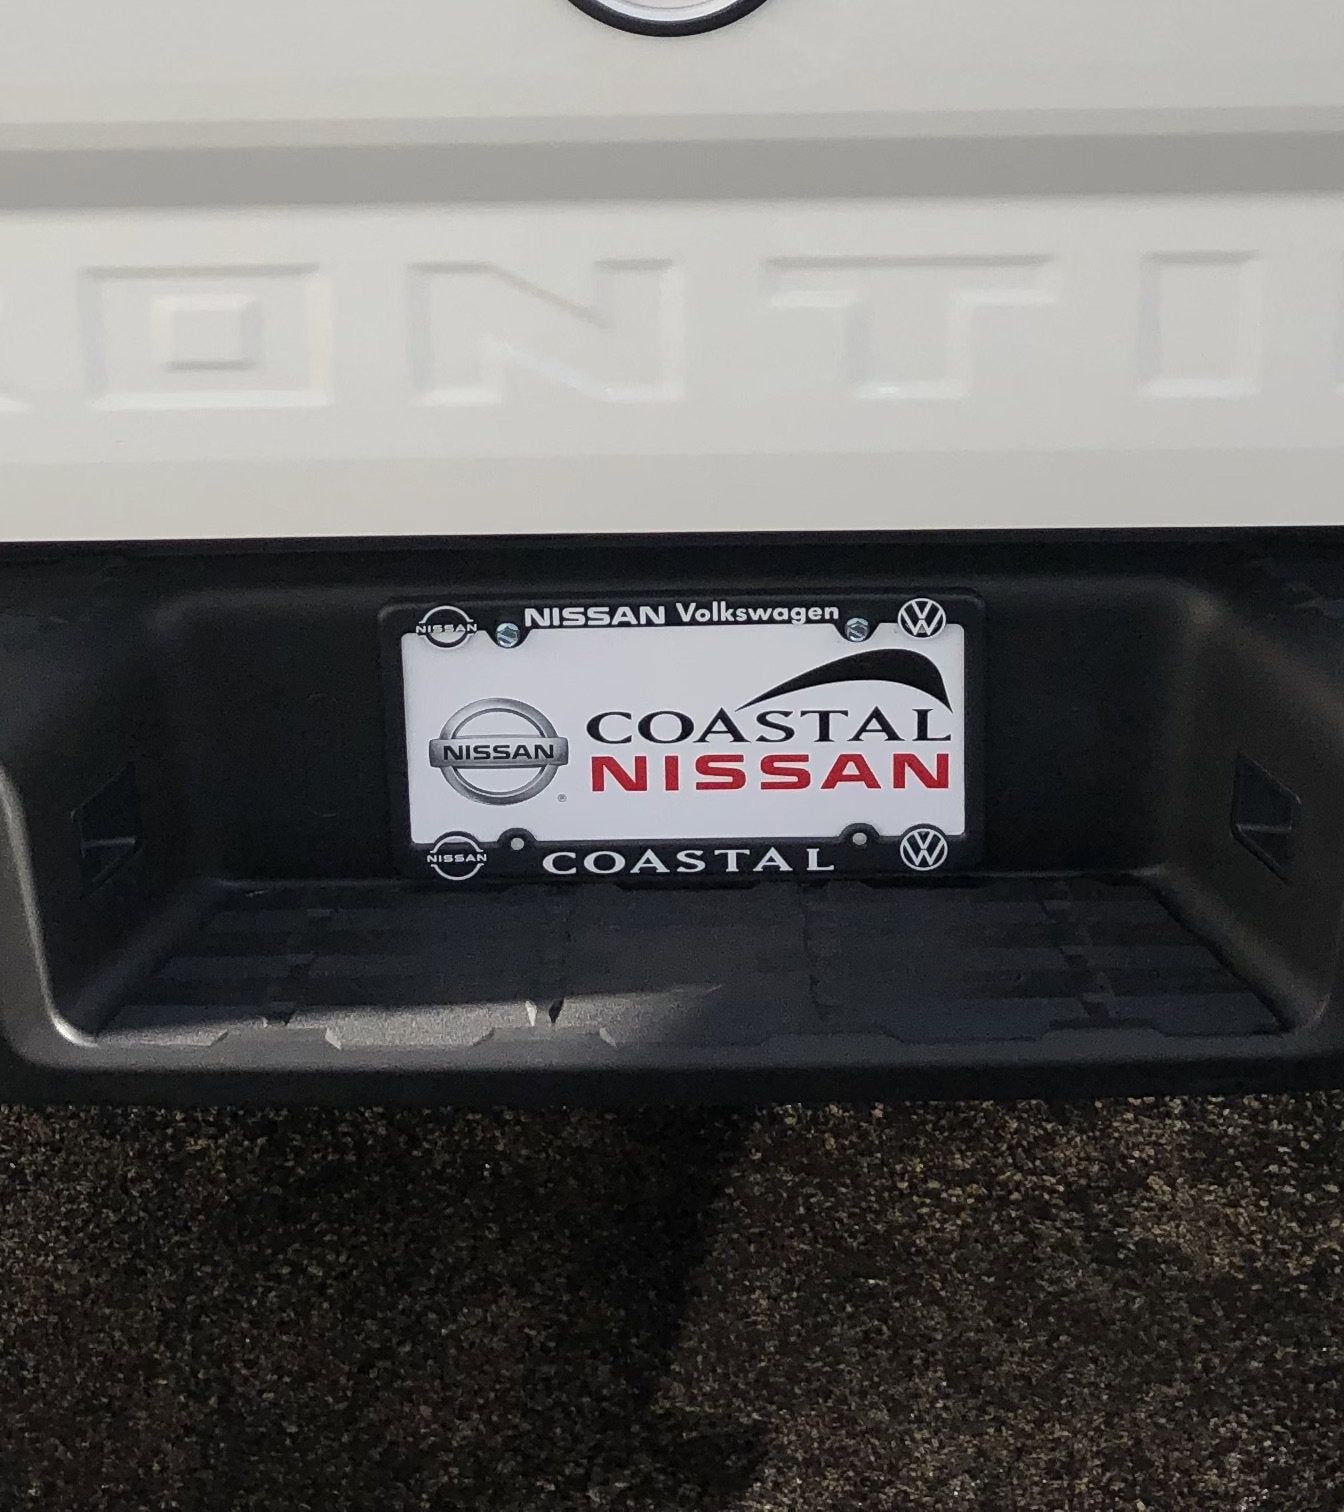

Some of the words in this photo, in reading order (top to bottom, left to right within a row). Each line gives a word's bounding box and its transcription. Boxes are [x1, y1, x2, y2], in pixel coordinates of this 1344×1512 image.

[524, 606, 666, 628] NISSAN
[676, 602, 840, 624] Volkswagen
[415, 623, 478, 634] NISSAN
[586, 707, 953, 744] COASTAL
[442, 741, 555, 762] NISSAN
[591, 753, 950, 792] NISSAN
[426, 851, 488, 865] NISSAN
[541, 847, 835, 875] COASTAL
